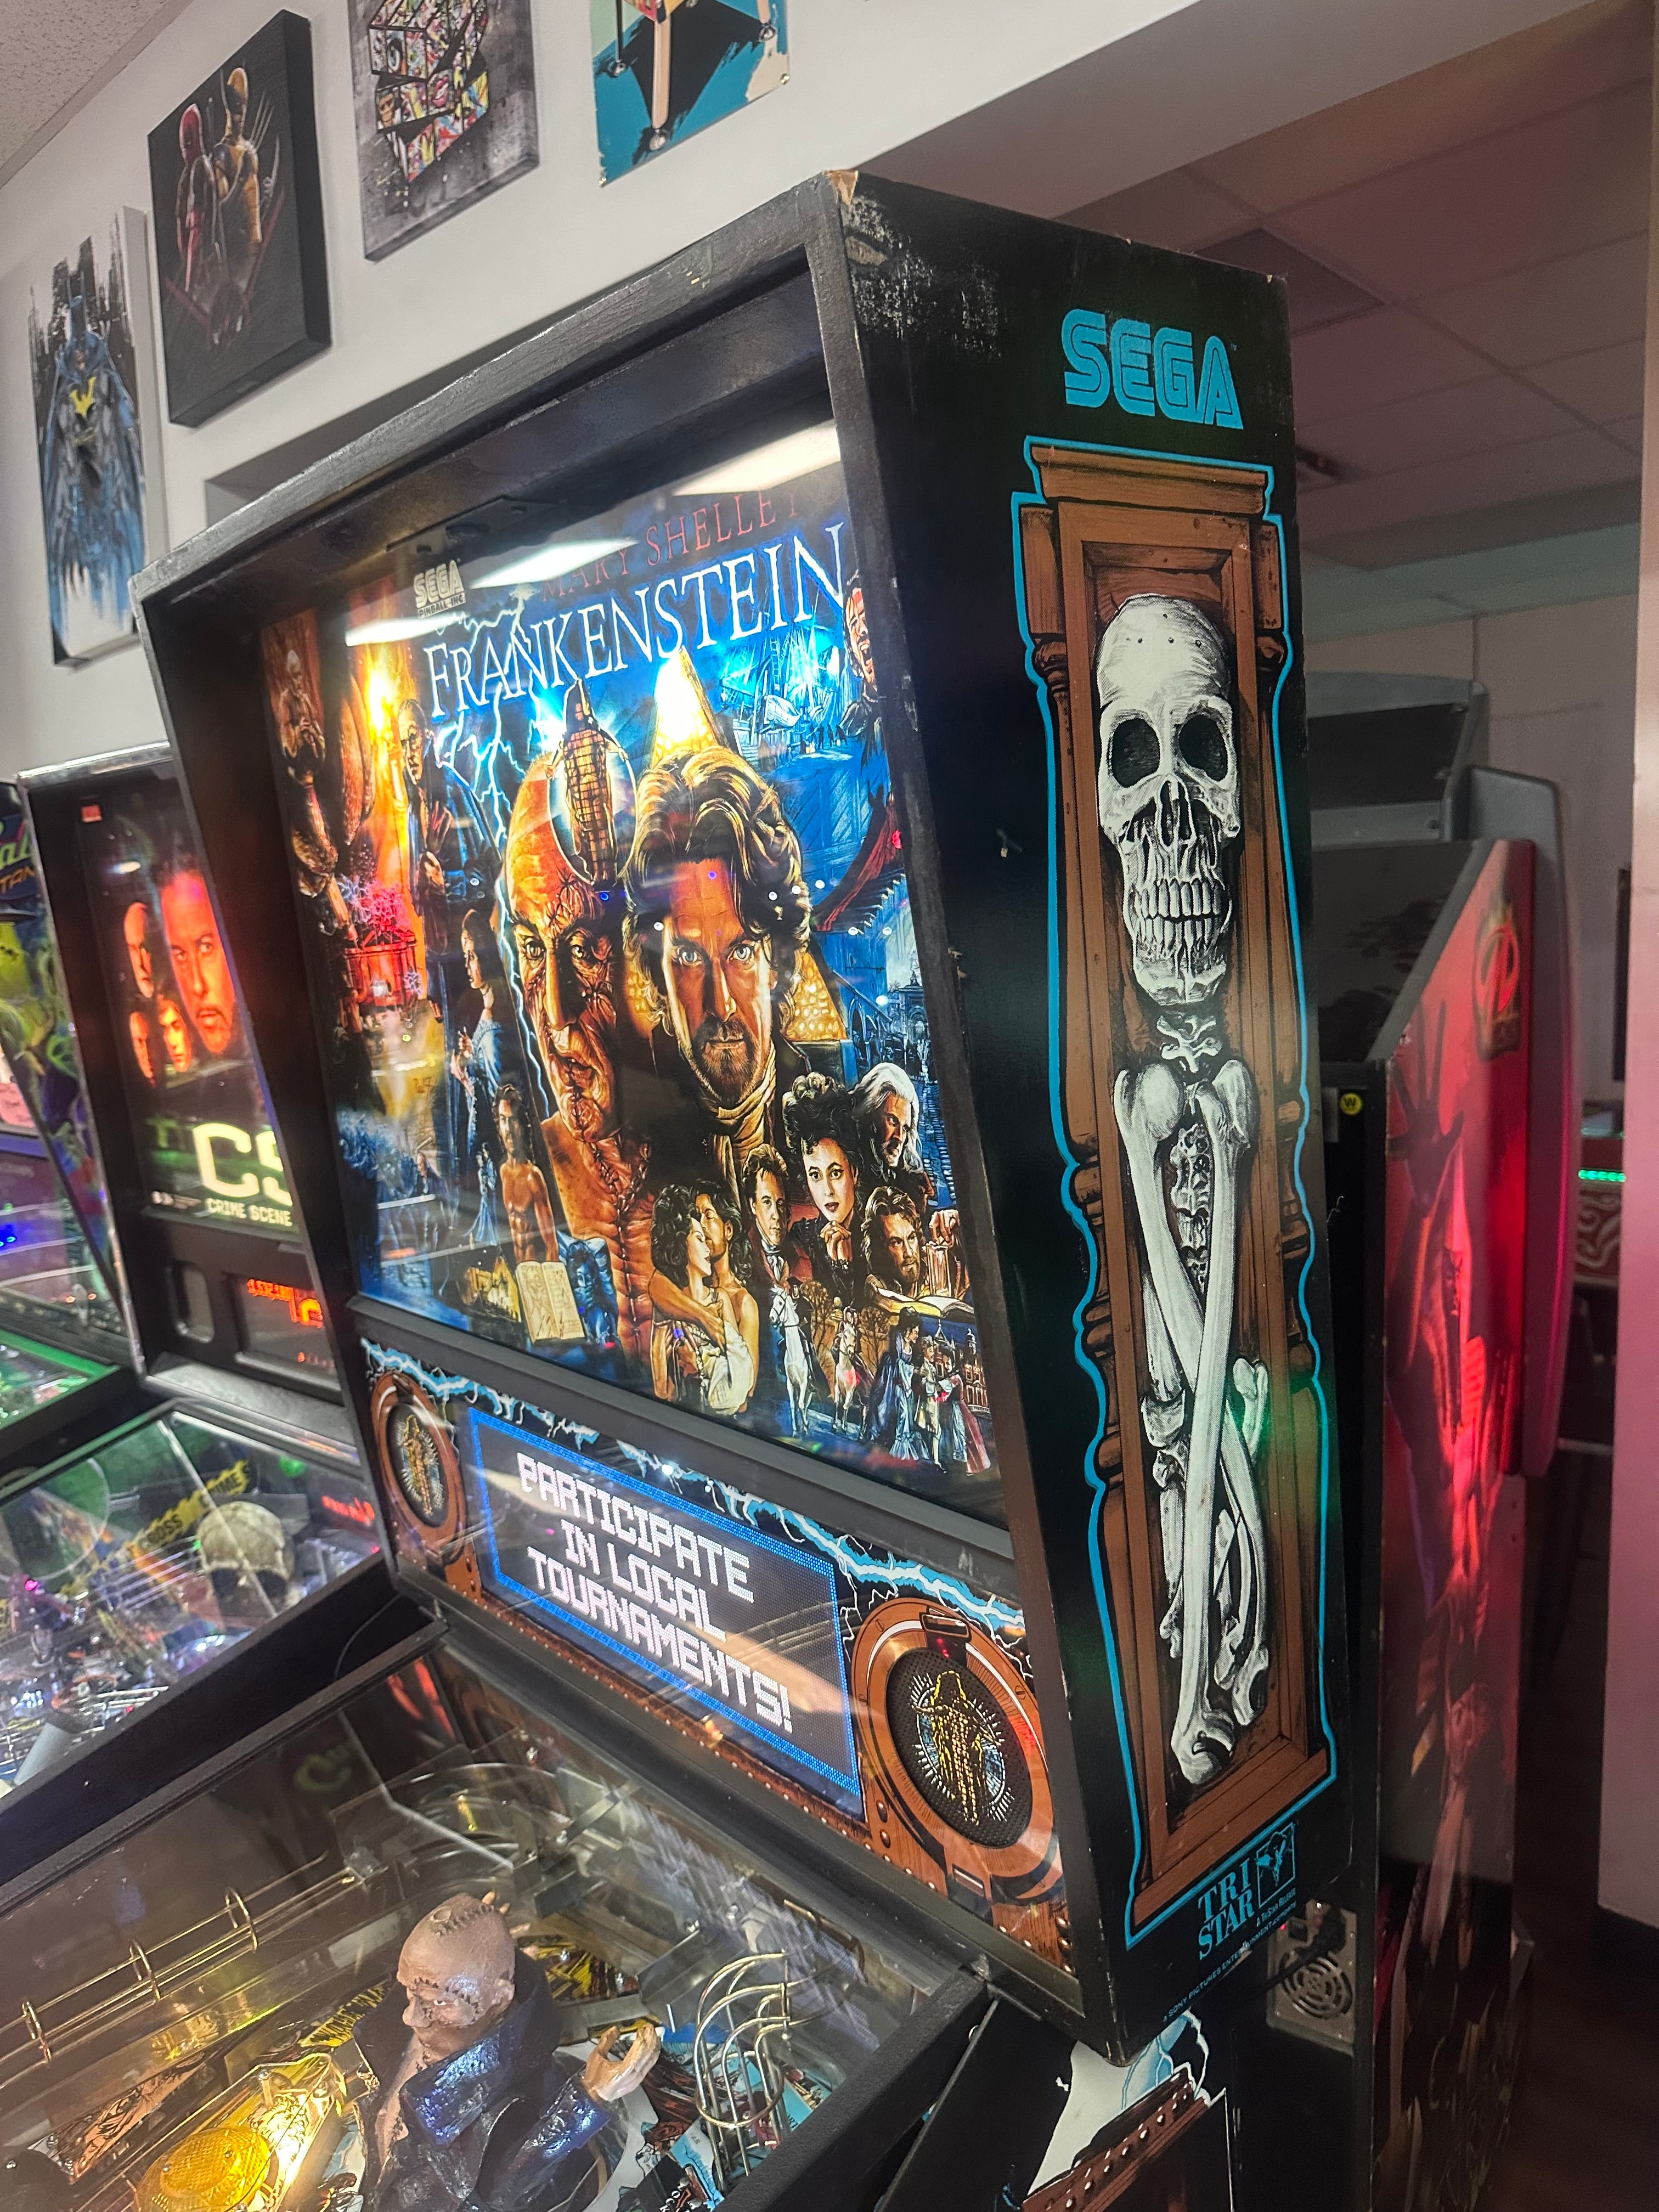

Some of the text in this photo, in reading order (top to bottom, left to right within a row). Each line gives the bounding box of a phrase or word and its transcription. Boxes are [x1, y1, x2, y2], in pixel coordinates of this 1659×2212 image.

[1062, 308, 1243, 430] SEGA
[414, 559, 465, 608] SEGA
[423, 521, 844, 718] FRANKENSTEIN
[204, 1198, 247, 1219] CRIME
[249, 1205, 293, 1227] SCENE
[517, 1452, 754, 1603] PARTICIPATE
[561, 1519, 726, 1643] IN LOCAL
[528, 1547, 793, 1734] TOURNAMENTS!
[1198, 1858, 1251, 1924] TRI
[1198, 1889, 1255, 1961] STAR
[1169, 1997, 1187, 2017] SONY
[1188, 1967, 1221, 2000] PICTURES
